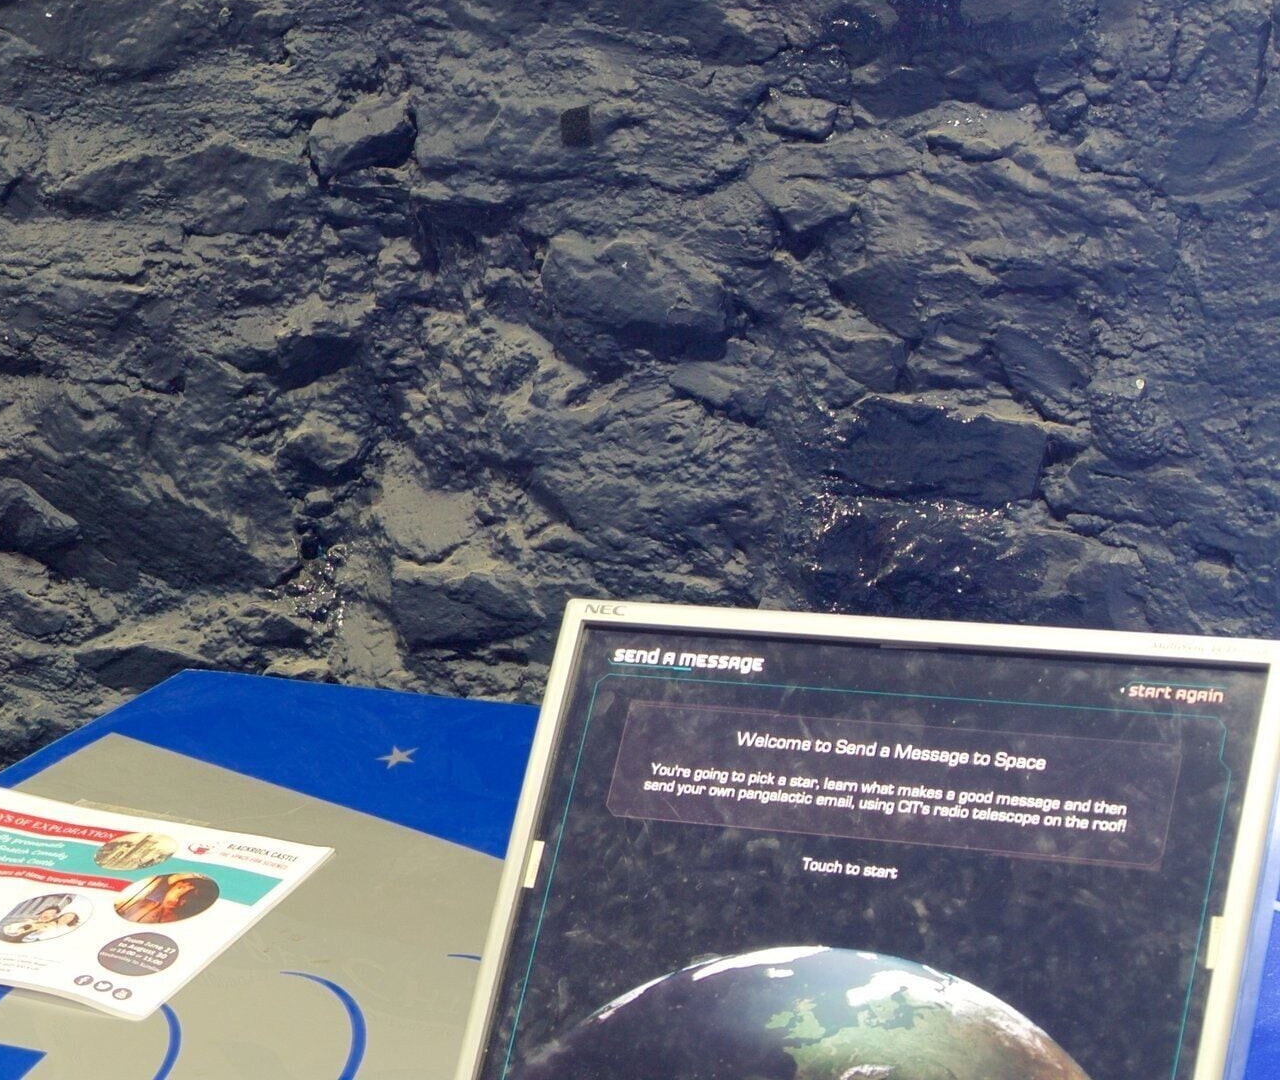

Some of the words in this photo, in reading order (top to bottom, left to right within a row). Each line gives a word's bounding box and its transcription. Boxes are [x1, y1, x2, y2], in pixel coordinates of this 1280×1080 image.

[585, 604, 627, 616] NEC
[737, 731, 811, 752] Welcome
[815, 738, 832, 753] to
[835, 739, 877, 757] Send
[880, 746, 891, 758] a
[894, 743, 969, 767] Message
[973, 751, 991, 766] to
[994, 751, 1047, 771] Space
[651, 762, 691, 778] You're
[694, 767, 728, 783] going
[731, 771, 745, 783] to
[748, 772, 775, 788] pick
[778, 777, 787, 787] a
[789, 776, 820, 790] star,
[823, 777, 858, 792] learn
[861, 781, 895, 795] what
[897, 784, 943, 800] makes
[946, 790, 955, 801] a
[958, 791, 993, 806] good
[996, 795, 1061, 813] message
[1064, 799, 1091, 813] and
[1094, 800, 1127, 816] then
[643, 780, 674, 793] send
[677, 783, 706, 797] your
[708, 786, 736, 798] own
[737, 787, 813, 805] pangalactic
[815, 794, 855, 810] email,
[858, 799, 894, 815] using
[897, 799, 931, 815] CIT's
[933, 804, 969, 819] radio
[972, 807, 1041, 827] telescope
[1044, 815, 1062, 827] on
[1065, 816, 1089, 830] the
[1092, 819, 1127, 834] roof!
[15, 816, 30, 826] OF
[32, 821, 118, 840] EXPLORATION
[26, 857, 56, 867] Castle
[227, 843, 270, 856] BLACKROCK
[270, 851, 298, 862] CASTLE
[802, 857, 843, 874] Touch
[845, 863, 860, 875] to
[863, 865, 898, 880] start
[26, 871, 46, 880] time
[46, 876, 88, 887] travelling
[123, 937, 145, 945] From
[144, 941, 164, 951] June
[128, 944, 156, 956] August
